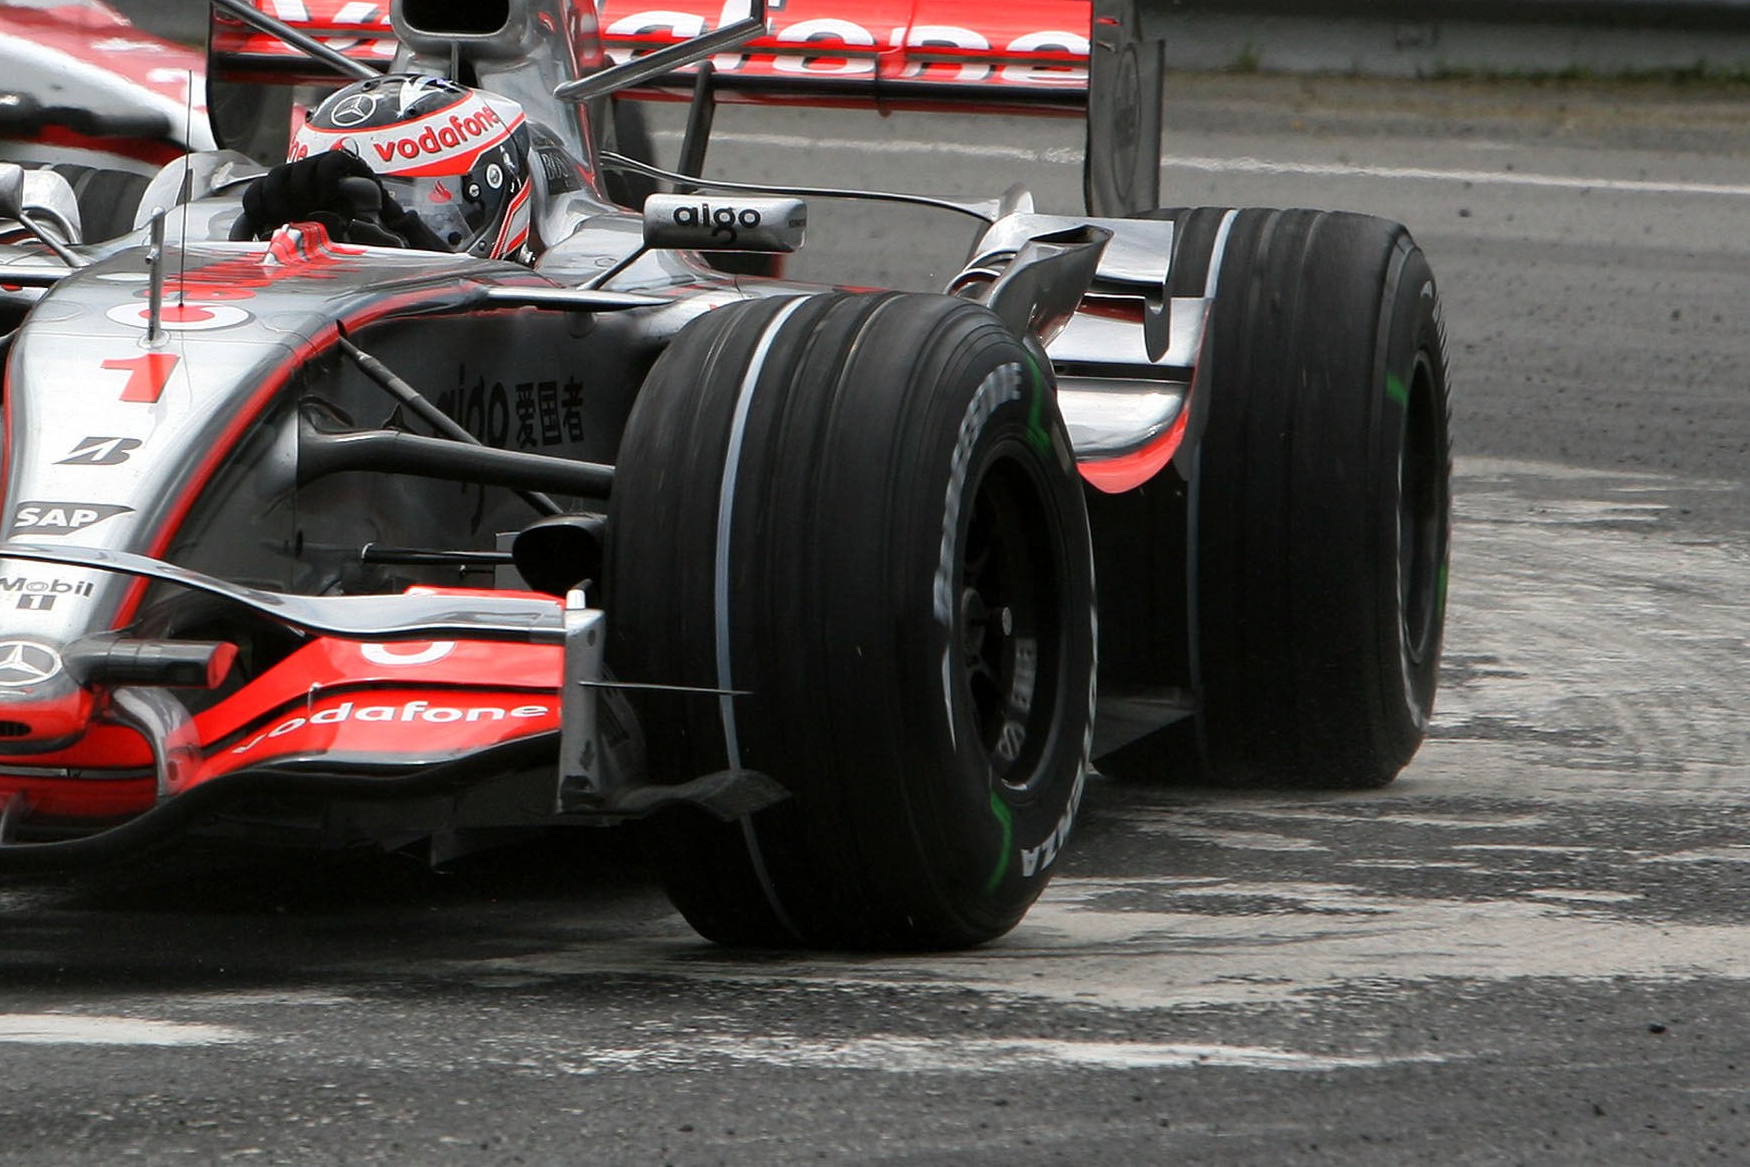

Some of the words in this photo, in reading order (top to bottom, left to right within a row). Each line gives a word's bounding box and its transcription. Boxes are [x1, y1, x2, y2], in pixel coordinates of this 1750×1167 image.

[373, 105, 501, 163] vodafone
[673, 202, 762, 245] aigo
[100, 352, 182, 404] 1
[14, 507, 98, 528] SAP
[231, 700, 548, 754] vodafone
